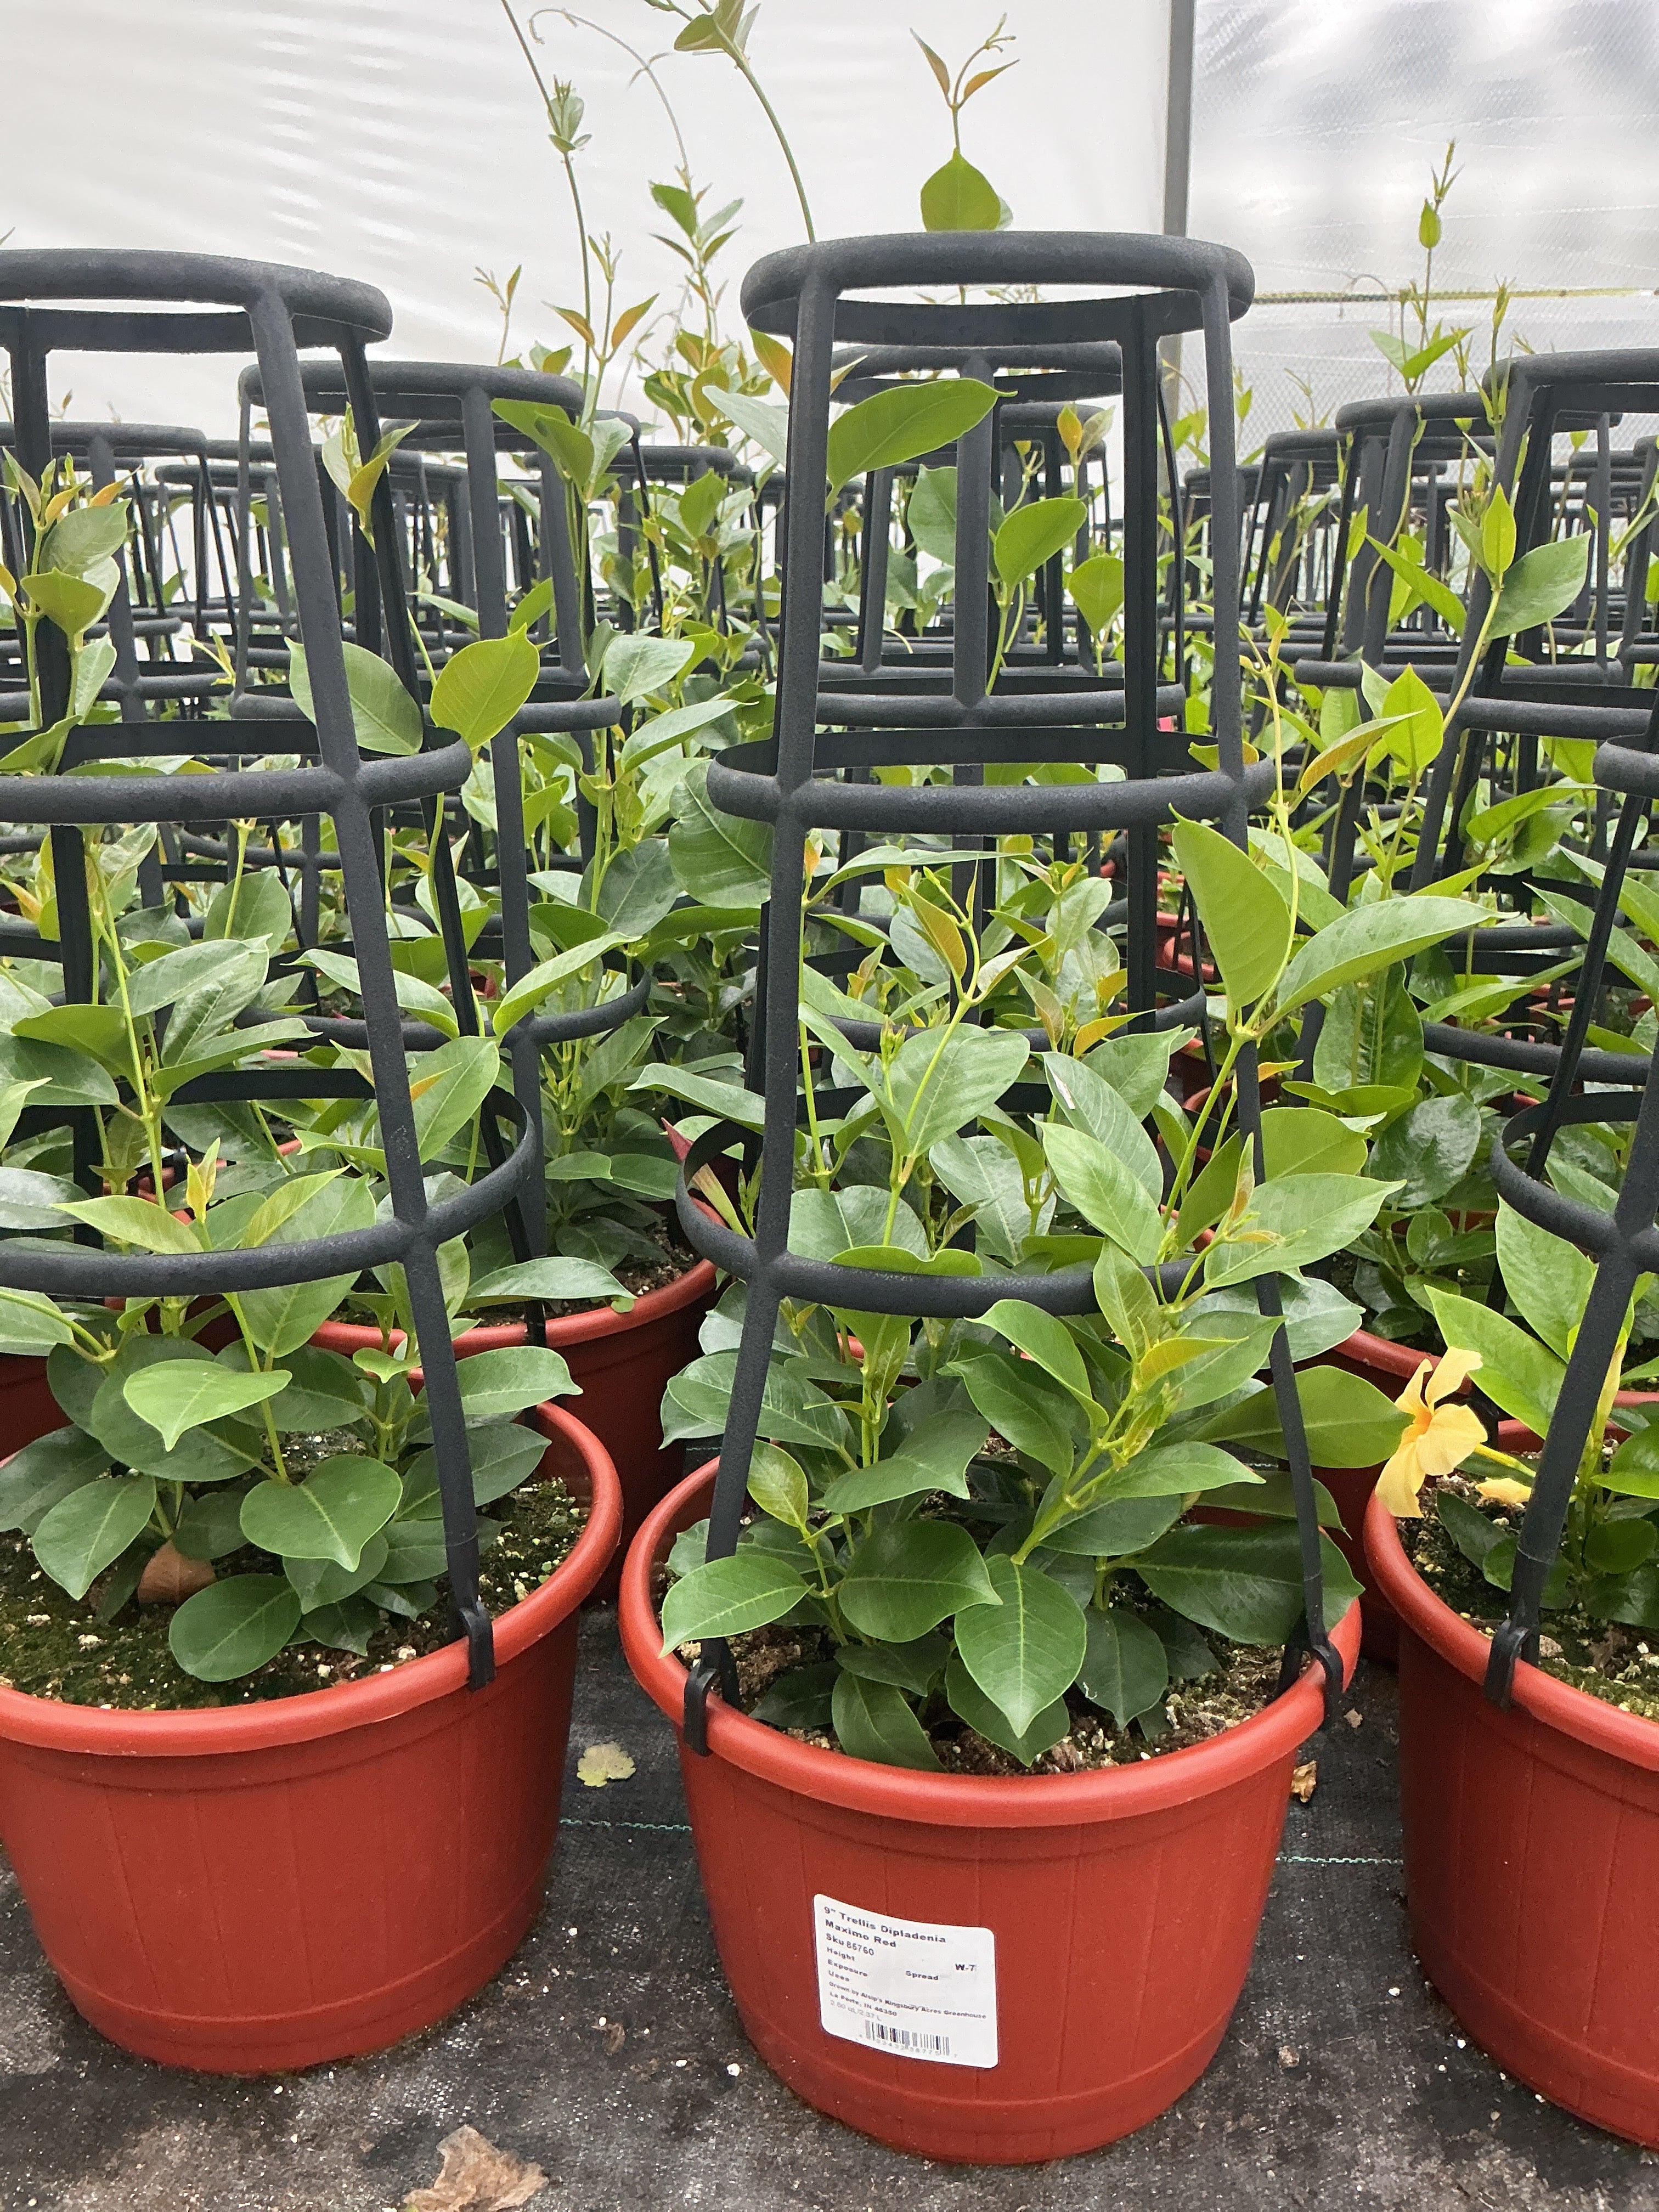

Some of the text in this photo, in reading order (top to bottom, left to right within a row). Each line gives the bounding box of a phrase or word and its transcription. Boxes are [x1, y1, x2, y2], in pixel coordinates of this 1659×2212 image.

[825, 1919, 896, 1948] Maximo Red
[839, 1912, 876, 1930] Trellis
[881, 1925, 946, 1943] Dipladenia
[826, 1933, 844, 1946] Sku
[827, 1947, 855, 1961] Height
[827, 1959, 868, 1977] Exposure
[905, 1970, 939, 1980] Spread
[828, 1981, 850, 1993] Grown
[921, 2006, 941, 2015] Acres
[943, 2010, 987, 2019] Greenhouse
